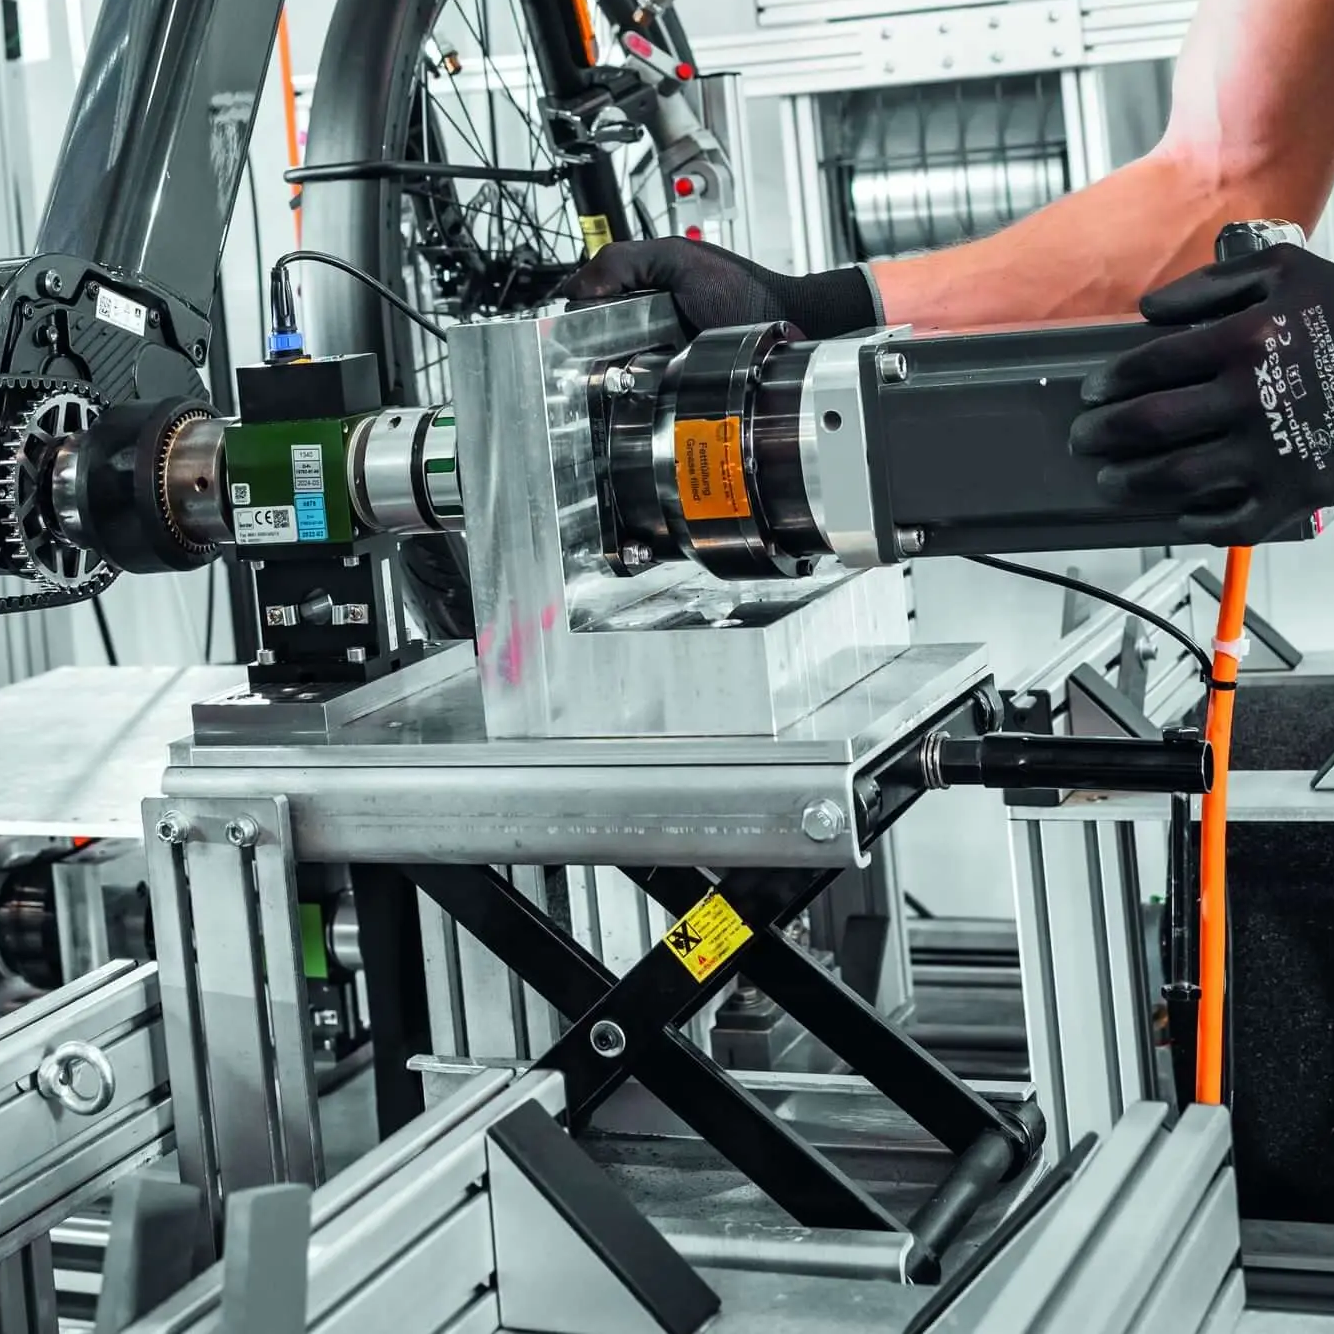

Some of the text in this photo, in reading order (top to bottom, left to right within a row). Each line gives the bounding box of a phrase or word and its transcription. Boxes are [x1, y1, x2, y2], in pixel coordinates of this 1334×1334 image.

[1254, 360, 1293, 455] uvex
[1264, 335, 1308, 459] unipur 6639
